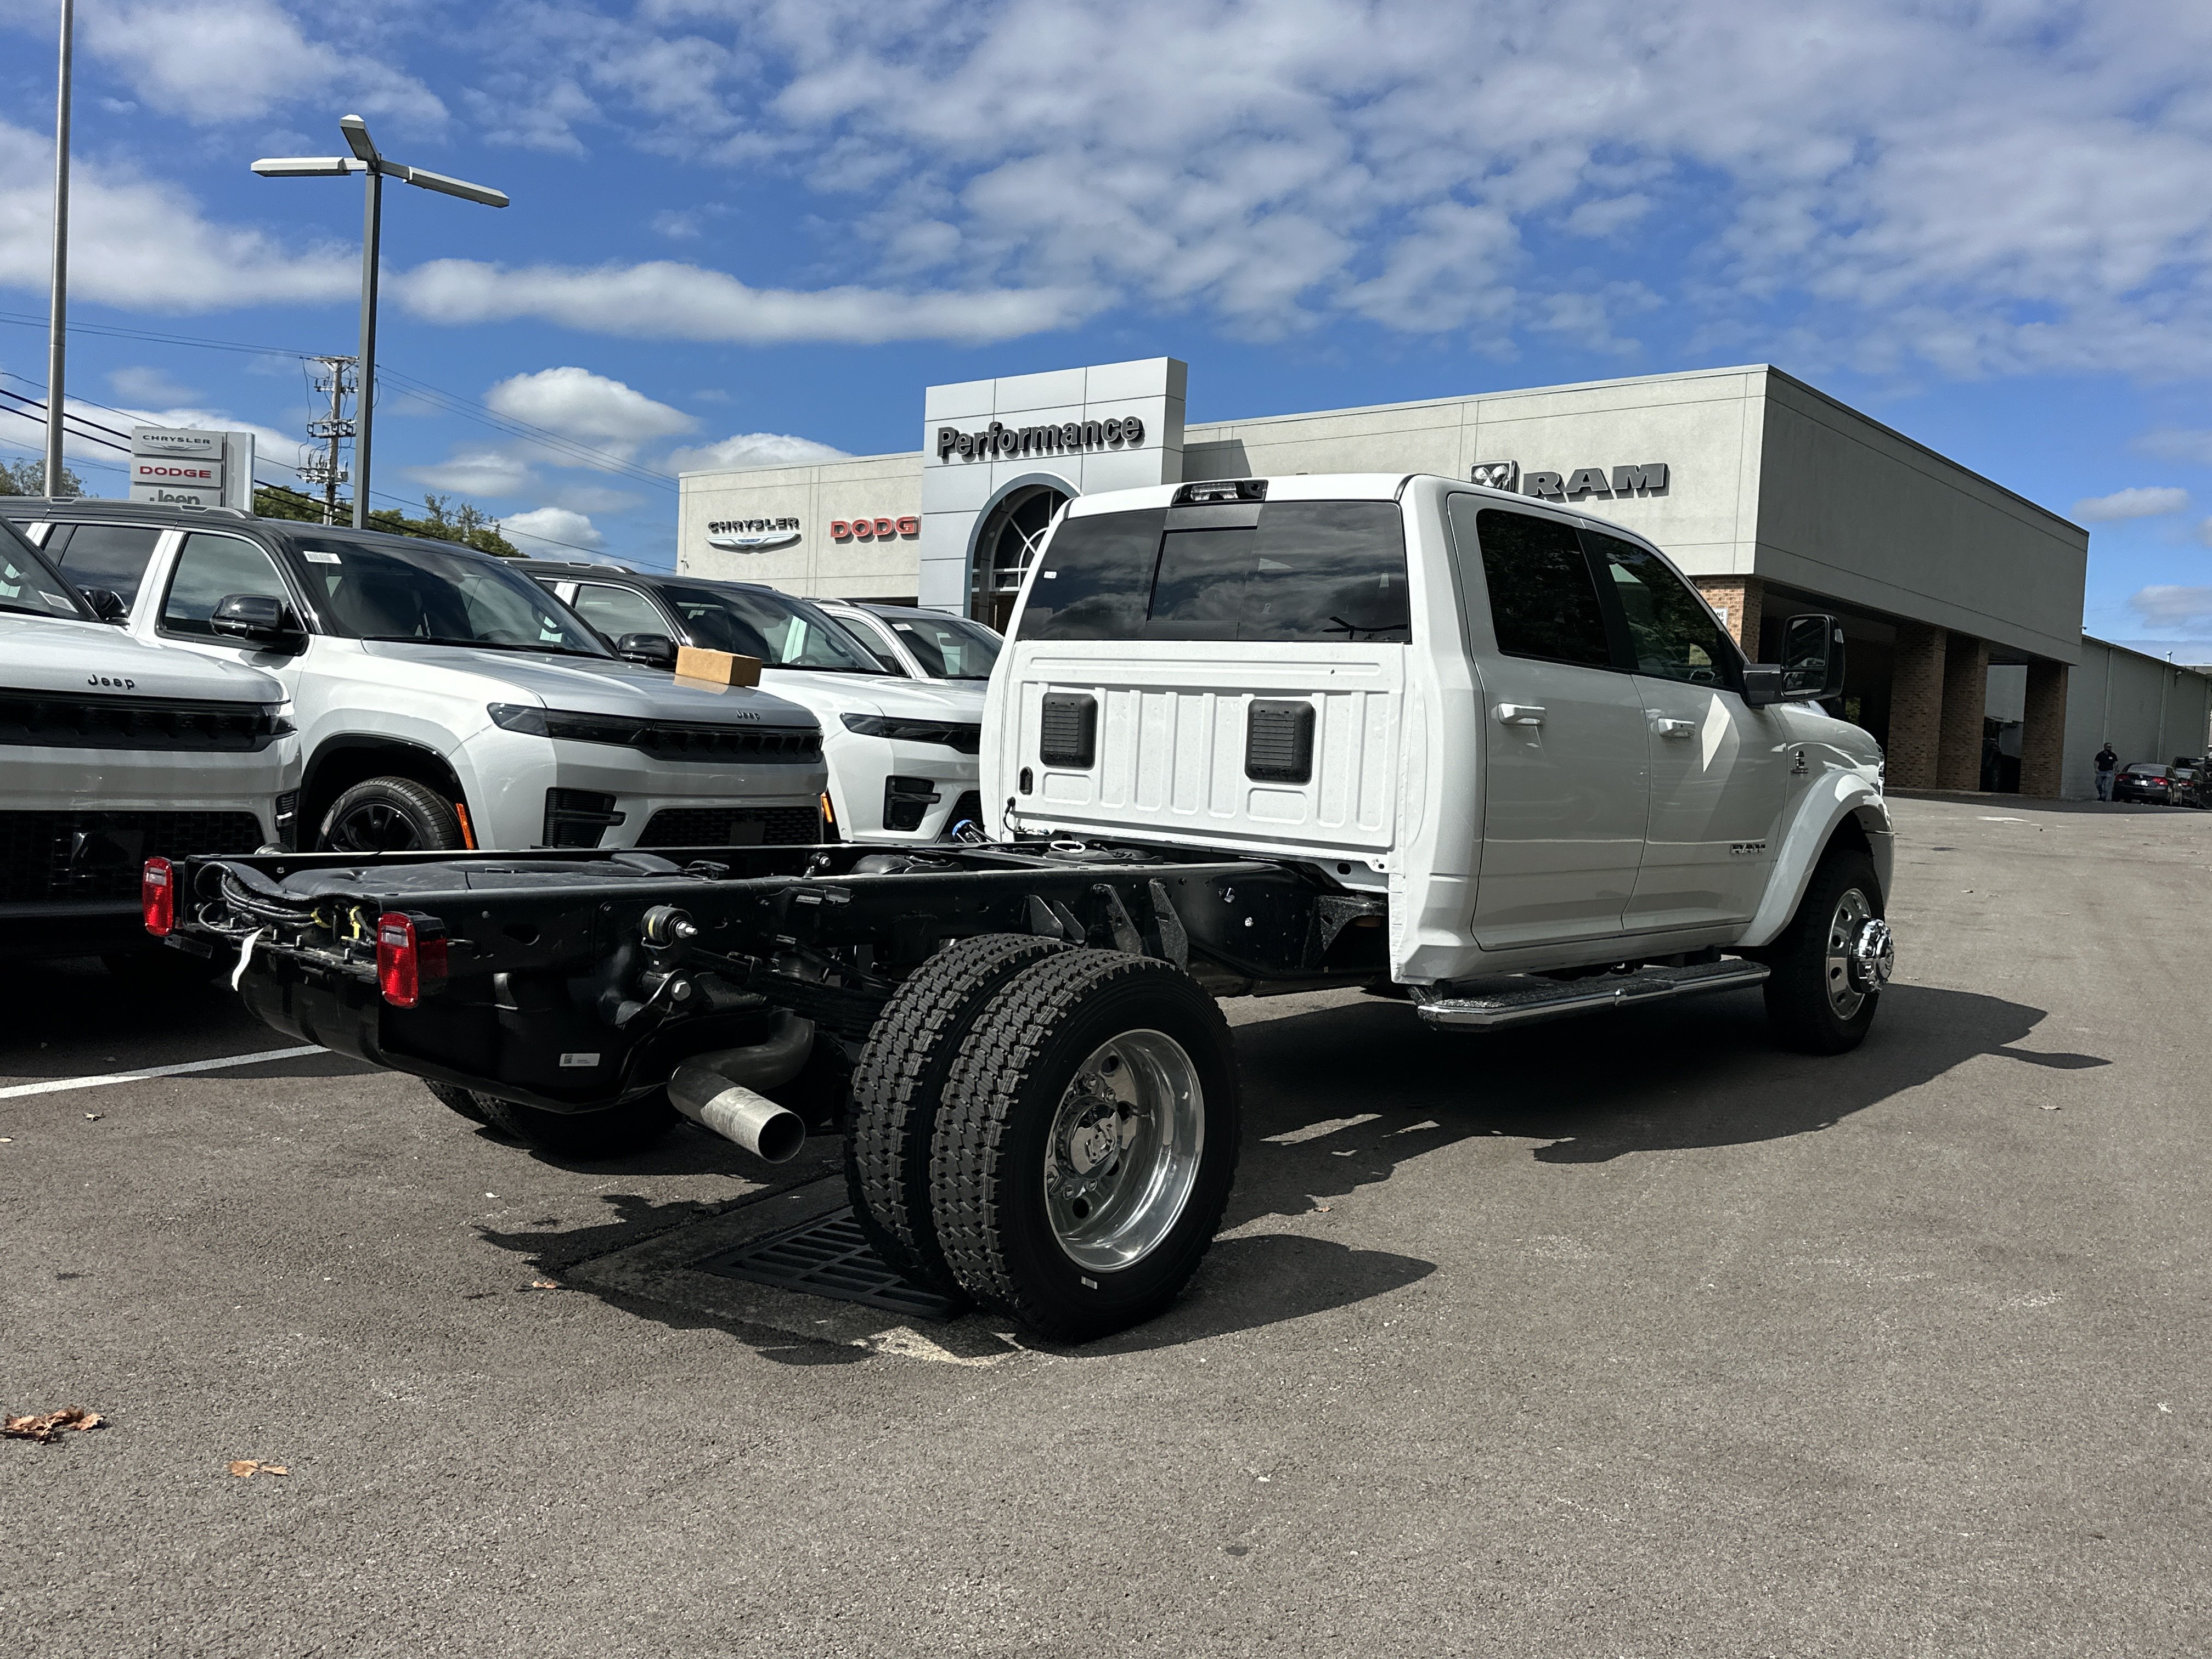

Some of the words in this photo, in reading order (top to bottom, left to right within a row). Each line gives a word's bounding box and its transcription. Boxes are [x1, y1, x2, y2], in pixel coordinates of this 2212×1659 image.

[143, 435, 211, 444] CHRYSLER
[937, 416, 1143, 457] Performance
[140, 466, 212, 478] DODGE
[1523, 462, 1670, 496] RAM
[708, 517, 800, 533] CHRYSLER
[831, 516, 921, 538] DODG
[87, 674, 136, 690] Jeep
[736, 709, 760, 721] Jeep
